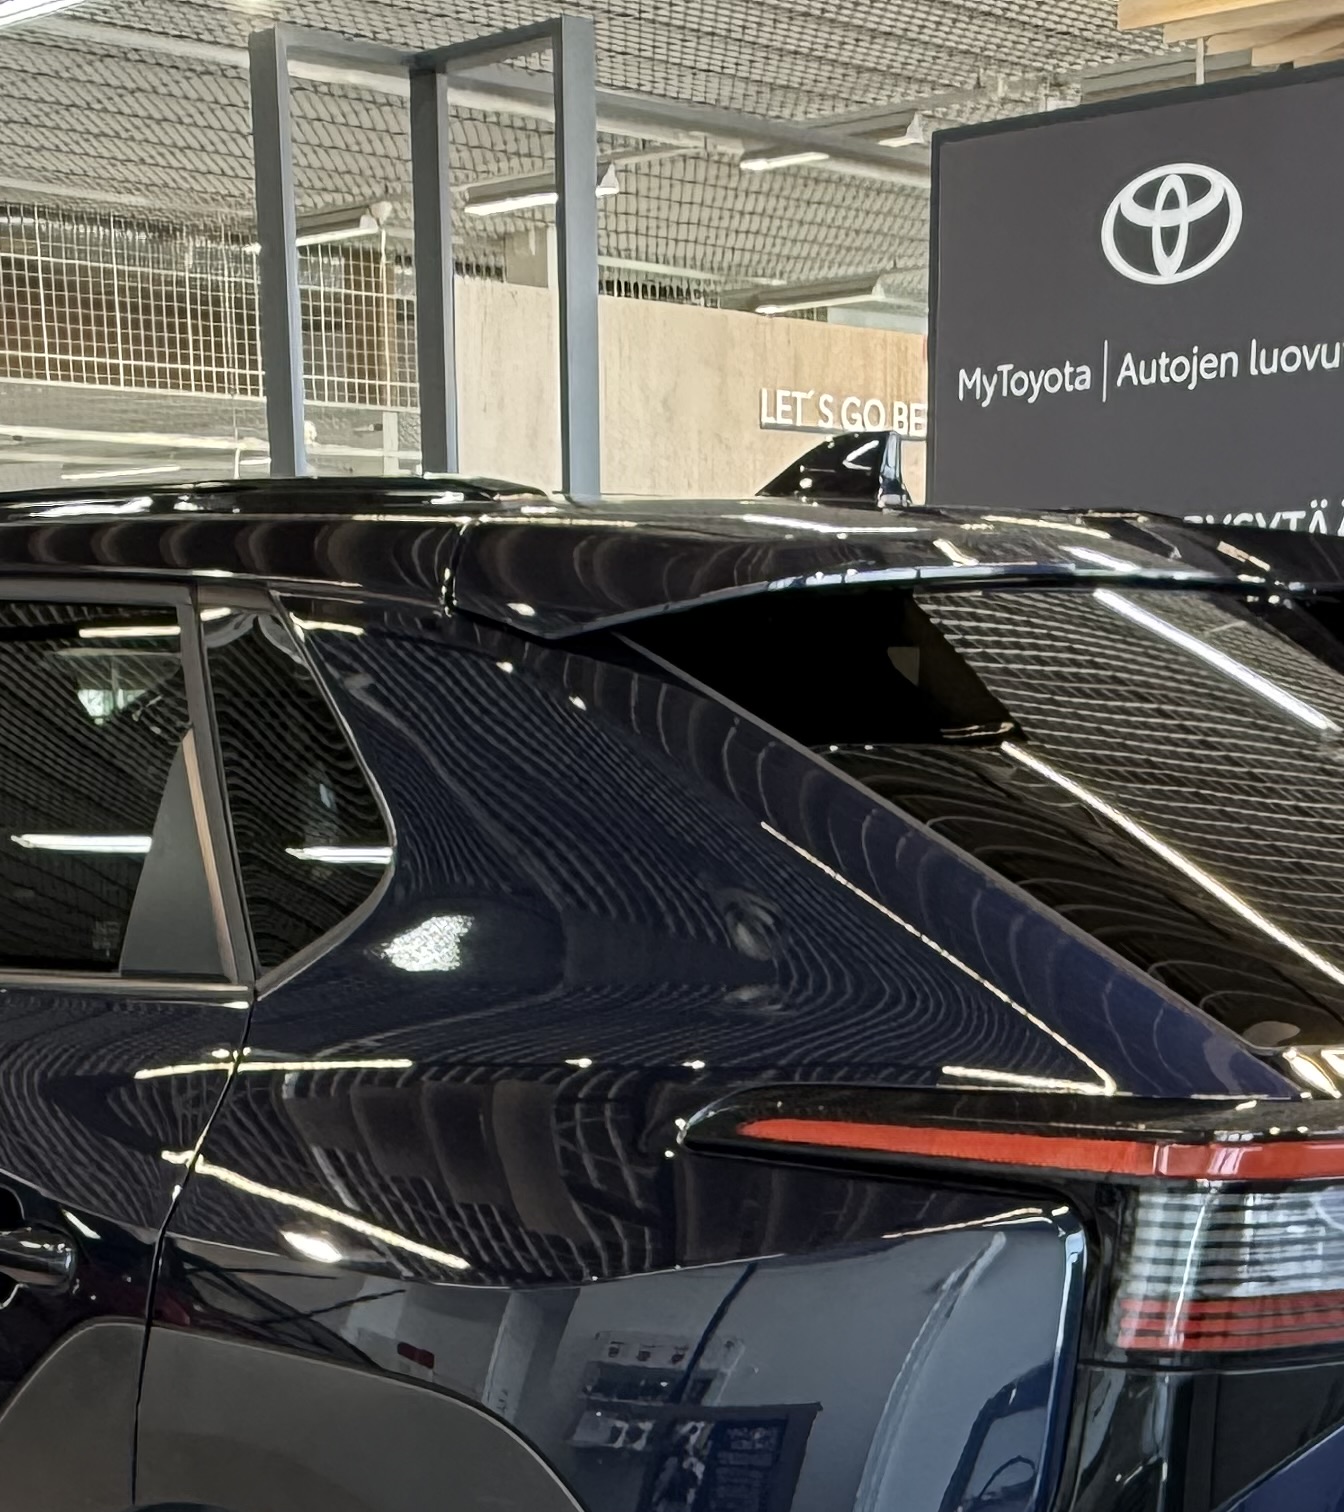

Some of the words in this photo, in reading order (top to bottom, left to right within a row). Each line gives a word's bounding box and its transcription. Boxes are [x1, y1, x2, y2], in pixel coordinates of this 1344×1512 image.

[958, 361, 1092, 408] MyToyota
[1116, 345, 1239, 390] Autojen
[841, 396, 886, 432] GO
